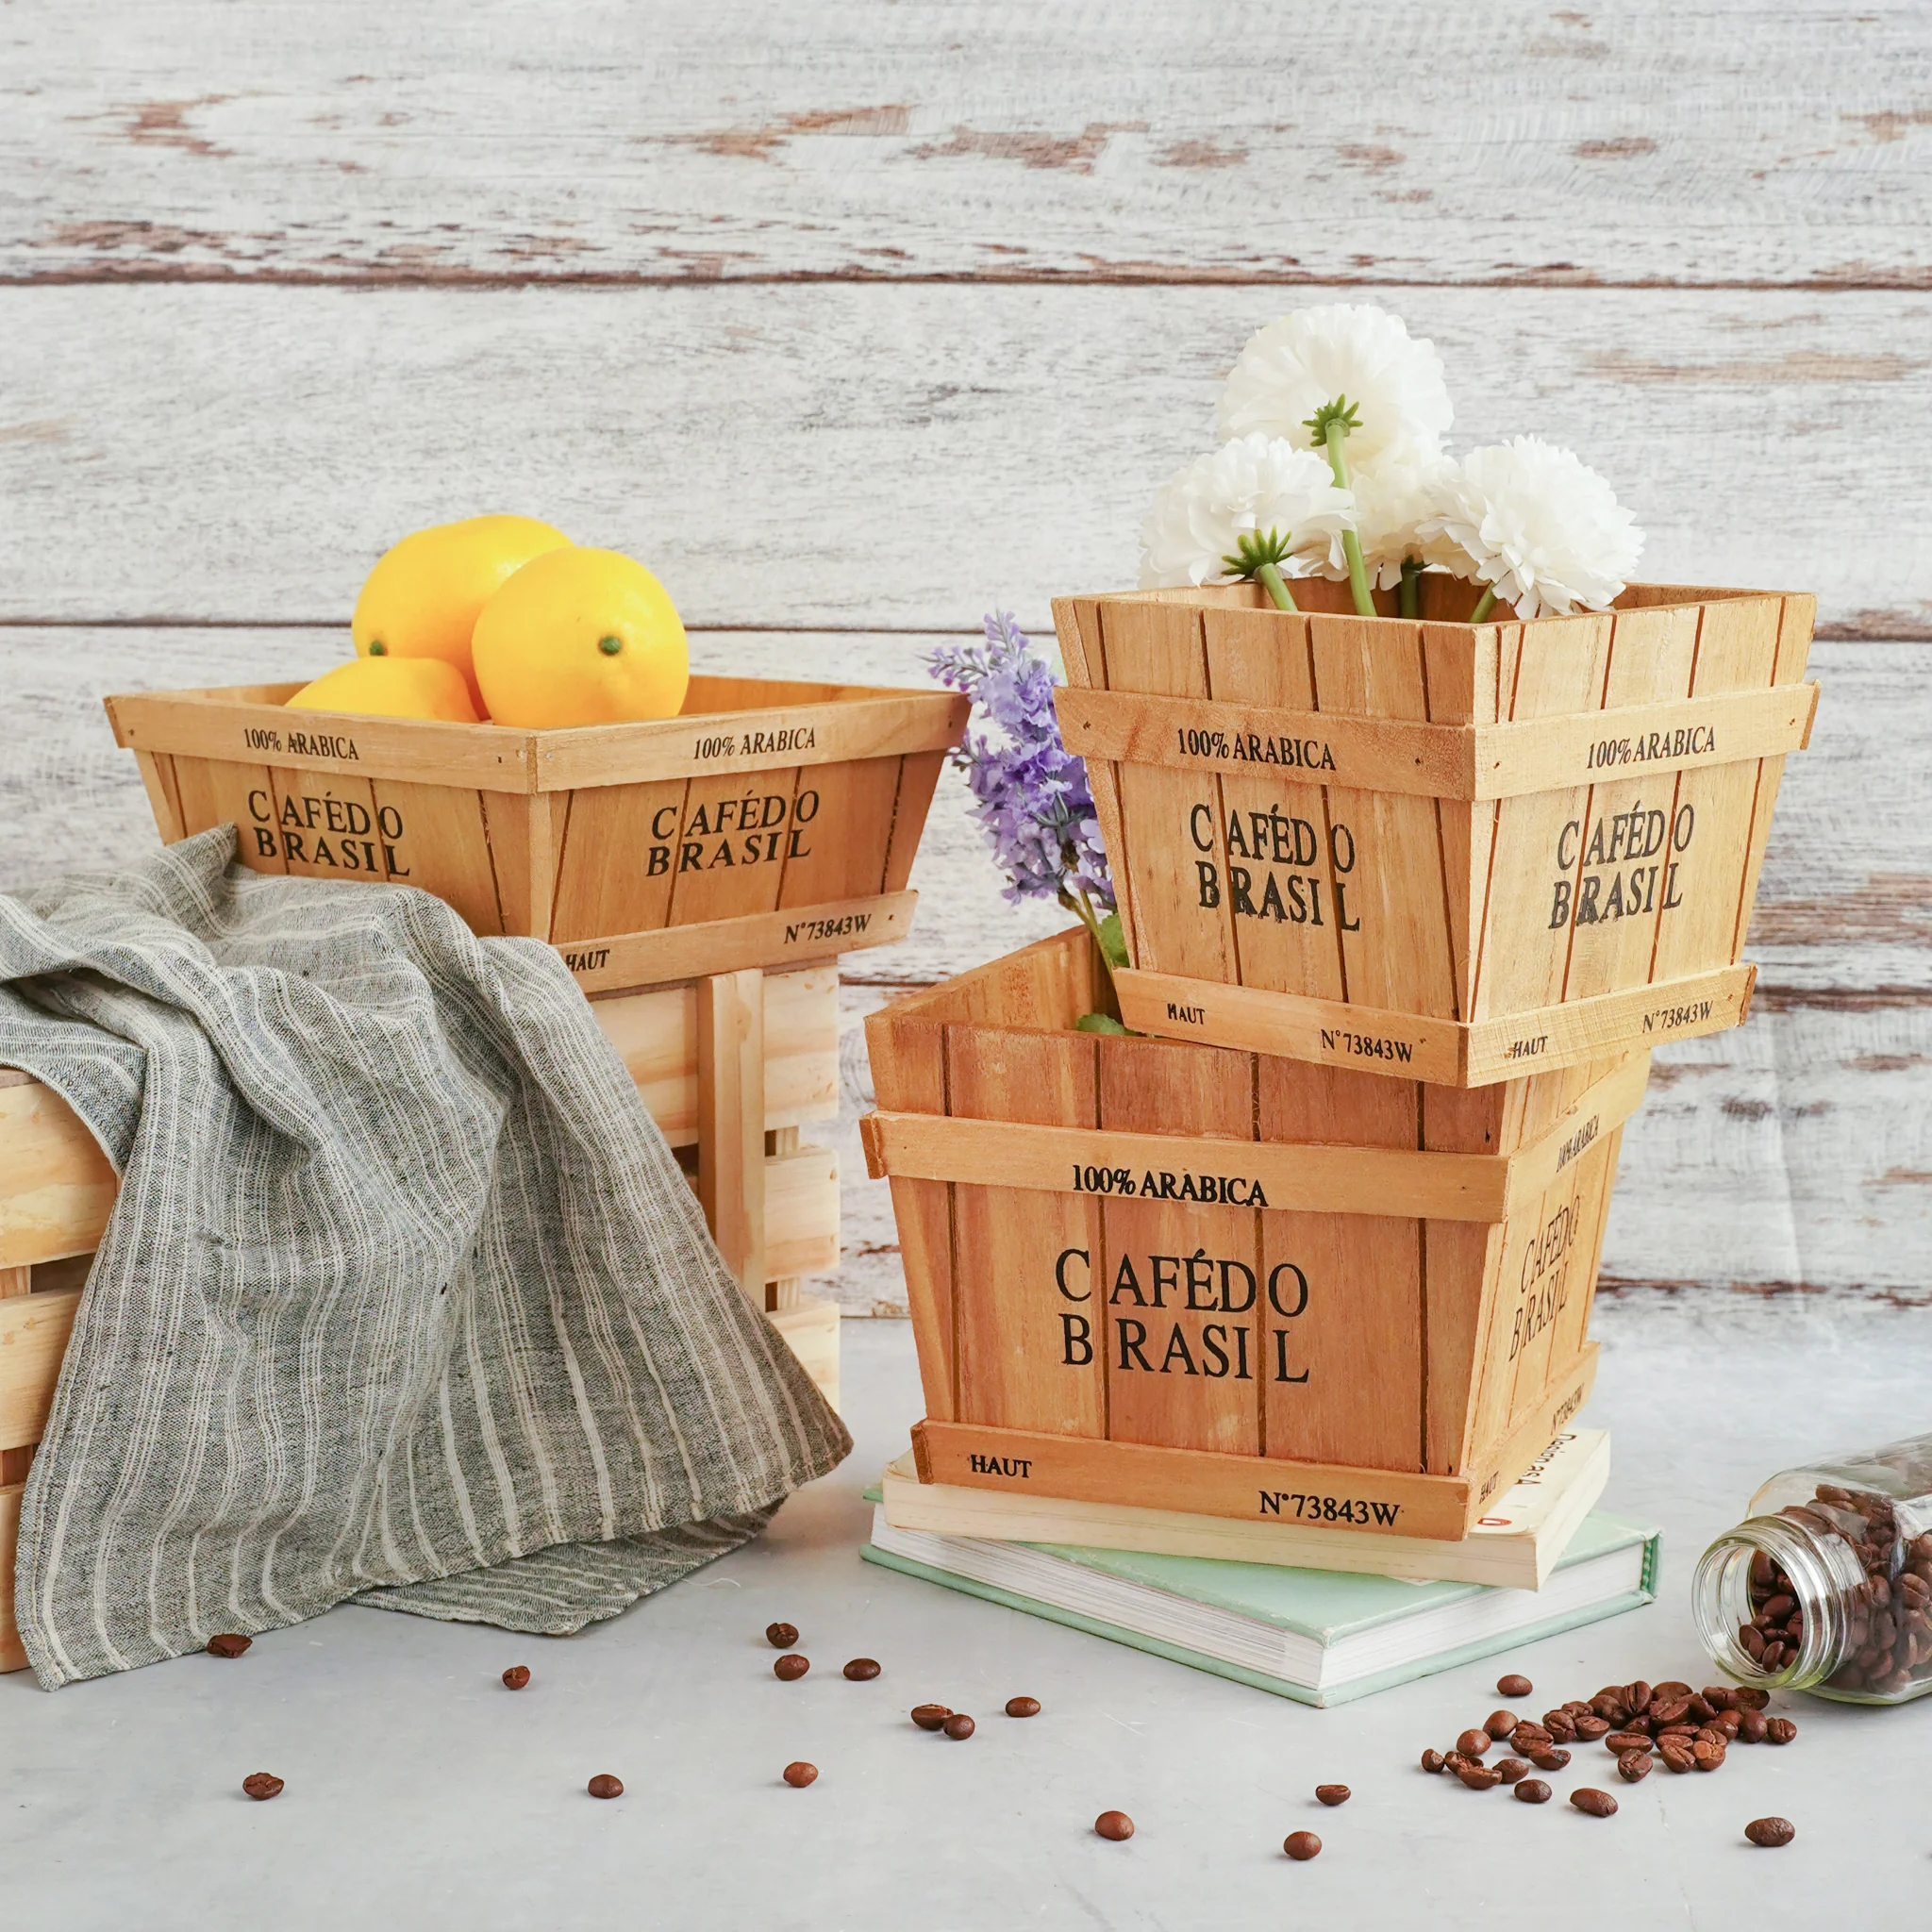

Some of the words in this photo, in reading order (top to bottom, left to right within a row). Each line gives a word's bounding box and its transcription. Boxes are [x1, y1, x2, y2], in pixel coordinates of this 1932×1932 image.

[244, 728, 282, 752] 100%
[288, 732, 359, 760] ARABICA
[693, 736, 736, 759] 100%
[741, 726, 816, 756] ARABICA
[1177, 727, 1229, 758] 100%
[1233, 732, 1336, 771] ARABICA
[1587, 738, 1631, 770] 100%
[1632, 725, 1715, 762] ARABICA
[253, 826, 410, 876] BRASIL
[646, 829, 812, 877] BRASIL
[1195, 859, 1360, 932] BRASIL
[1548, 862, 1684, 930] BRASIL
[566, 949, 610, 973] HAUT
[1167, 1003, 1206, 1025] HAUT
[1512, 1036, 1548, 1059] HAUT
[1073, 1165, 1136, 1195] 100%
[1140, 1170, 1269, 1207] ARABICA
[1058, 1312, 1310, 1384] BRASIL
[970, 1454, 1032, 1479] HAUT
